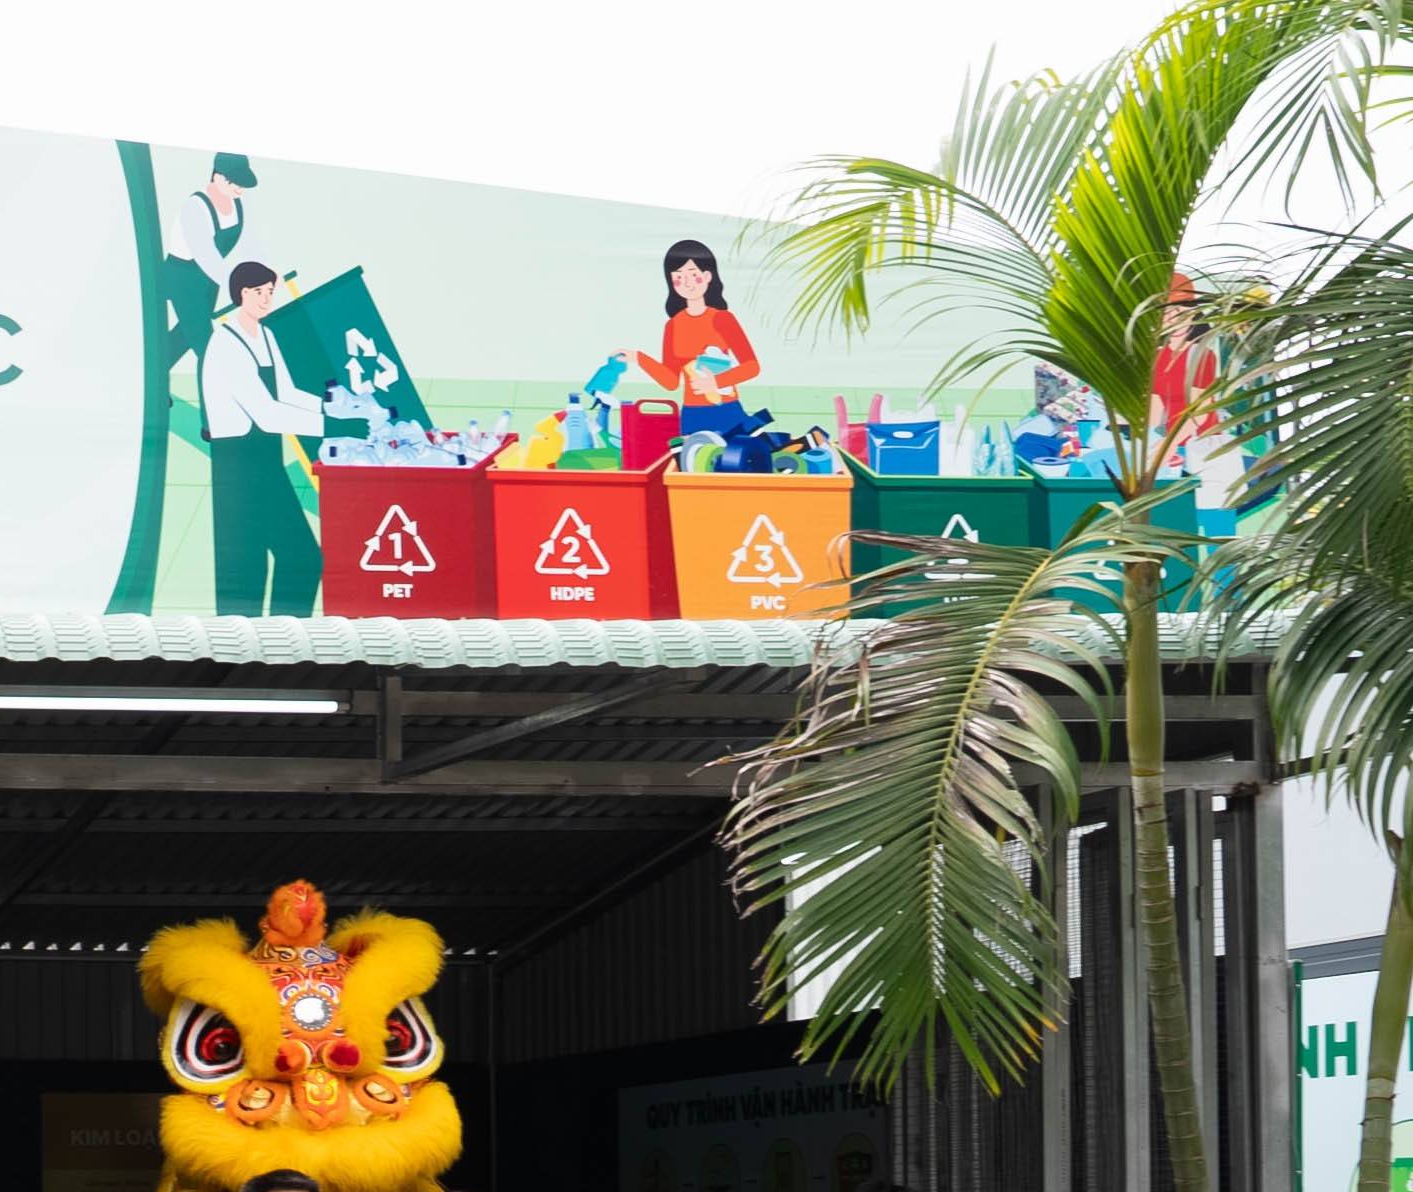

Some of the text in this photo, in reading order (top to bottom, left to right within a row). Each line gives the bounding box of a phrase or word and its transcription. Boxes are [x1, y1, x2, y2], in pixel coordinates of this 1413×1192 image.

[387, 532, 402, 559] 1
[560, 536, 582, 563] 2
[754, 544, 775, 573] 3
[382, 583, 414, 598] PET
[550, 586, 595, 602] HDPE
[750, 595, 786, 611] PVC
[647, 1103, 682, 1130] QUY
[69, 1128, 158, 1150] KIM LOẠ
